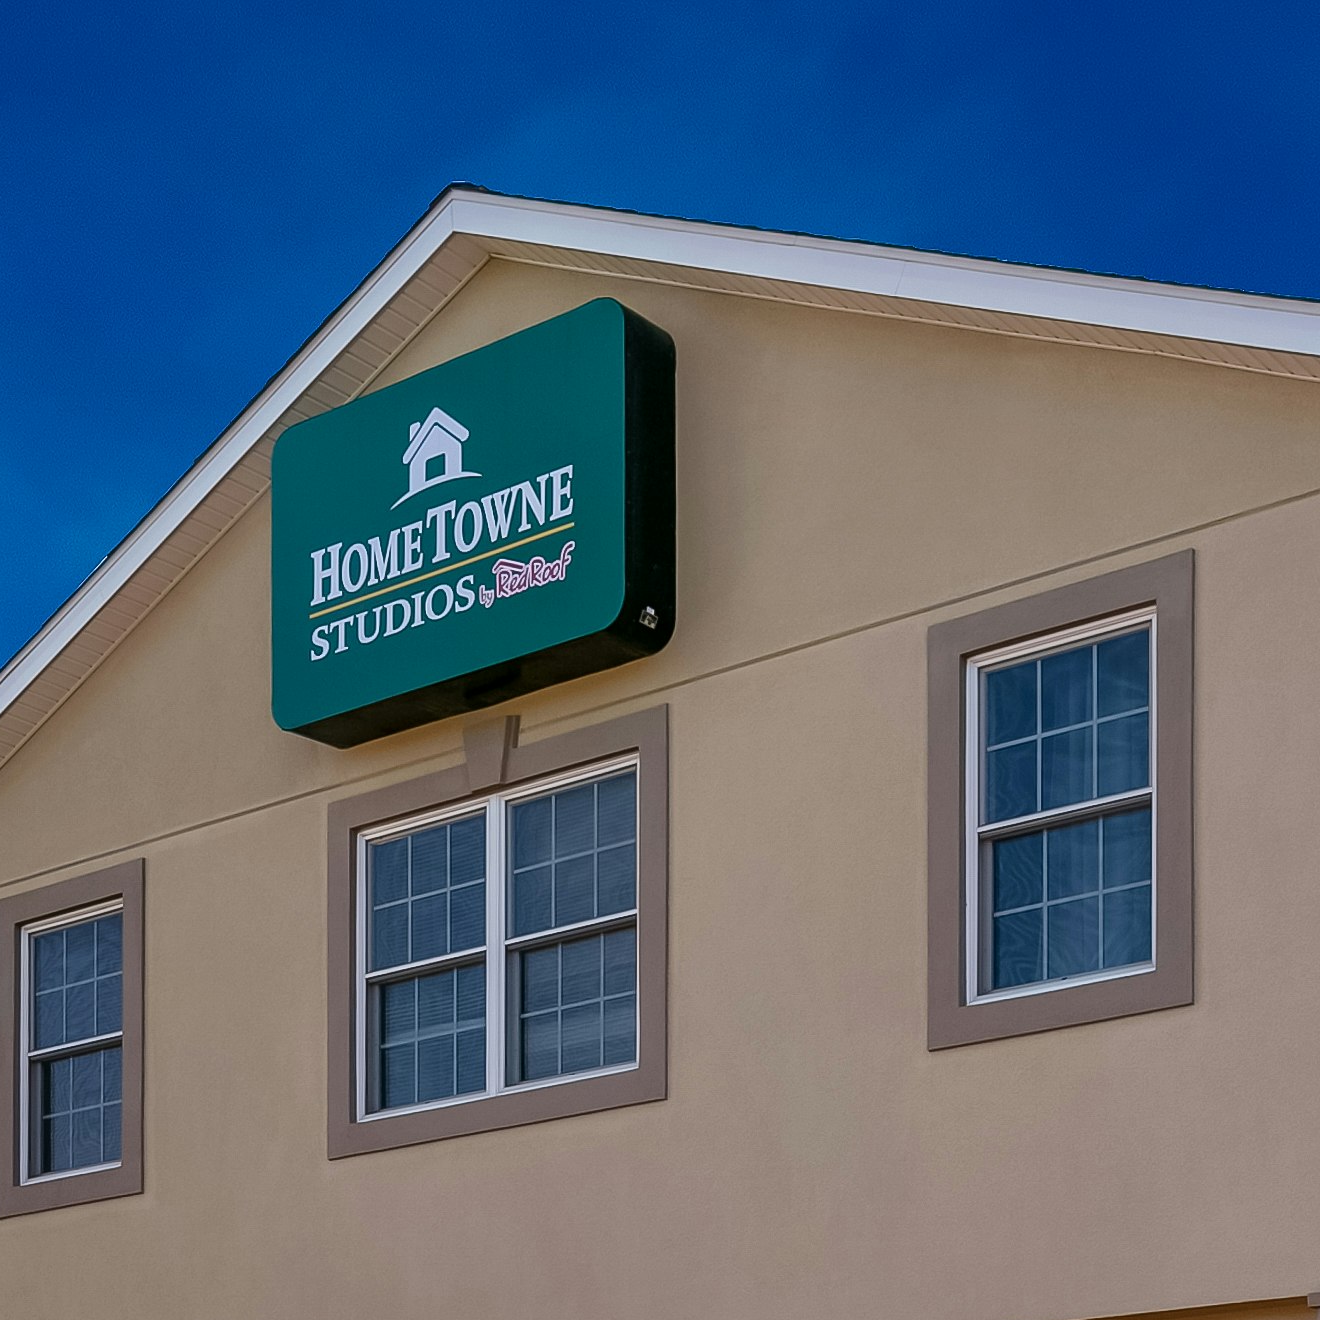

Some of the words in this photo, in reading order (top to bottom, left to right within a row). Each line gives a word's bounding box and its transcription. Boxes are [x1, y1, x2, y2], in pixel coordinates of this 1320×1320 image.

[310, 574, 476, 662] STUDIOS
[479, 584, 495, 609] by
[529, 540, 576, 587] Roof
